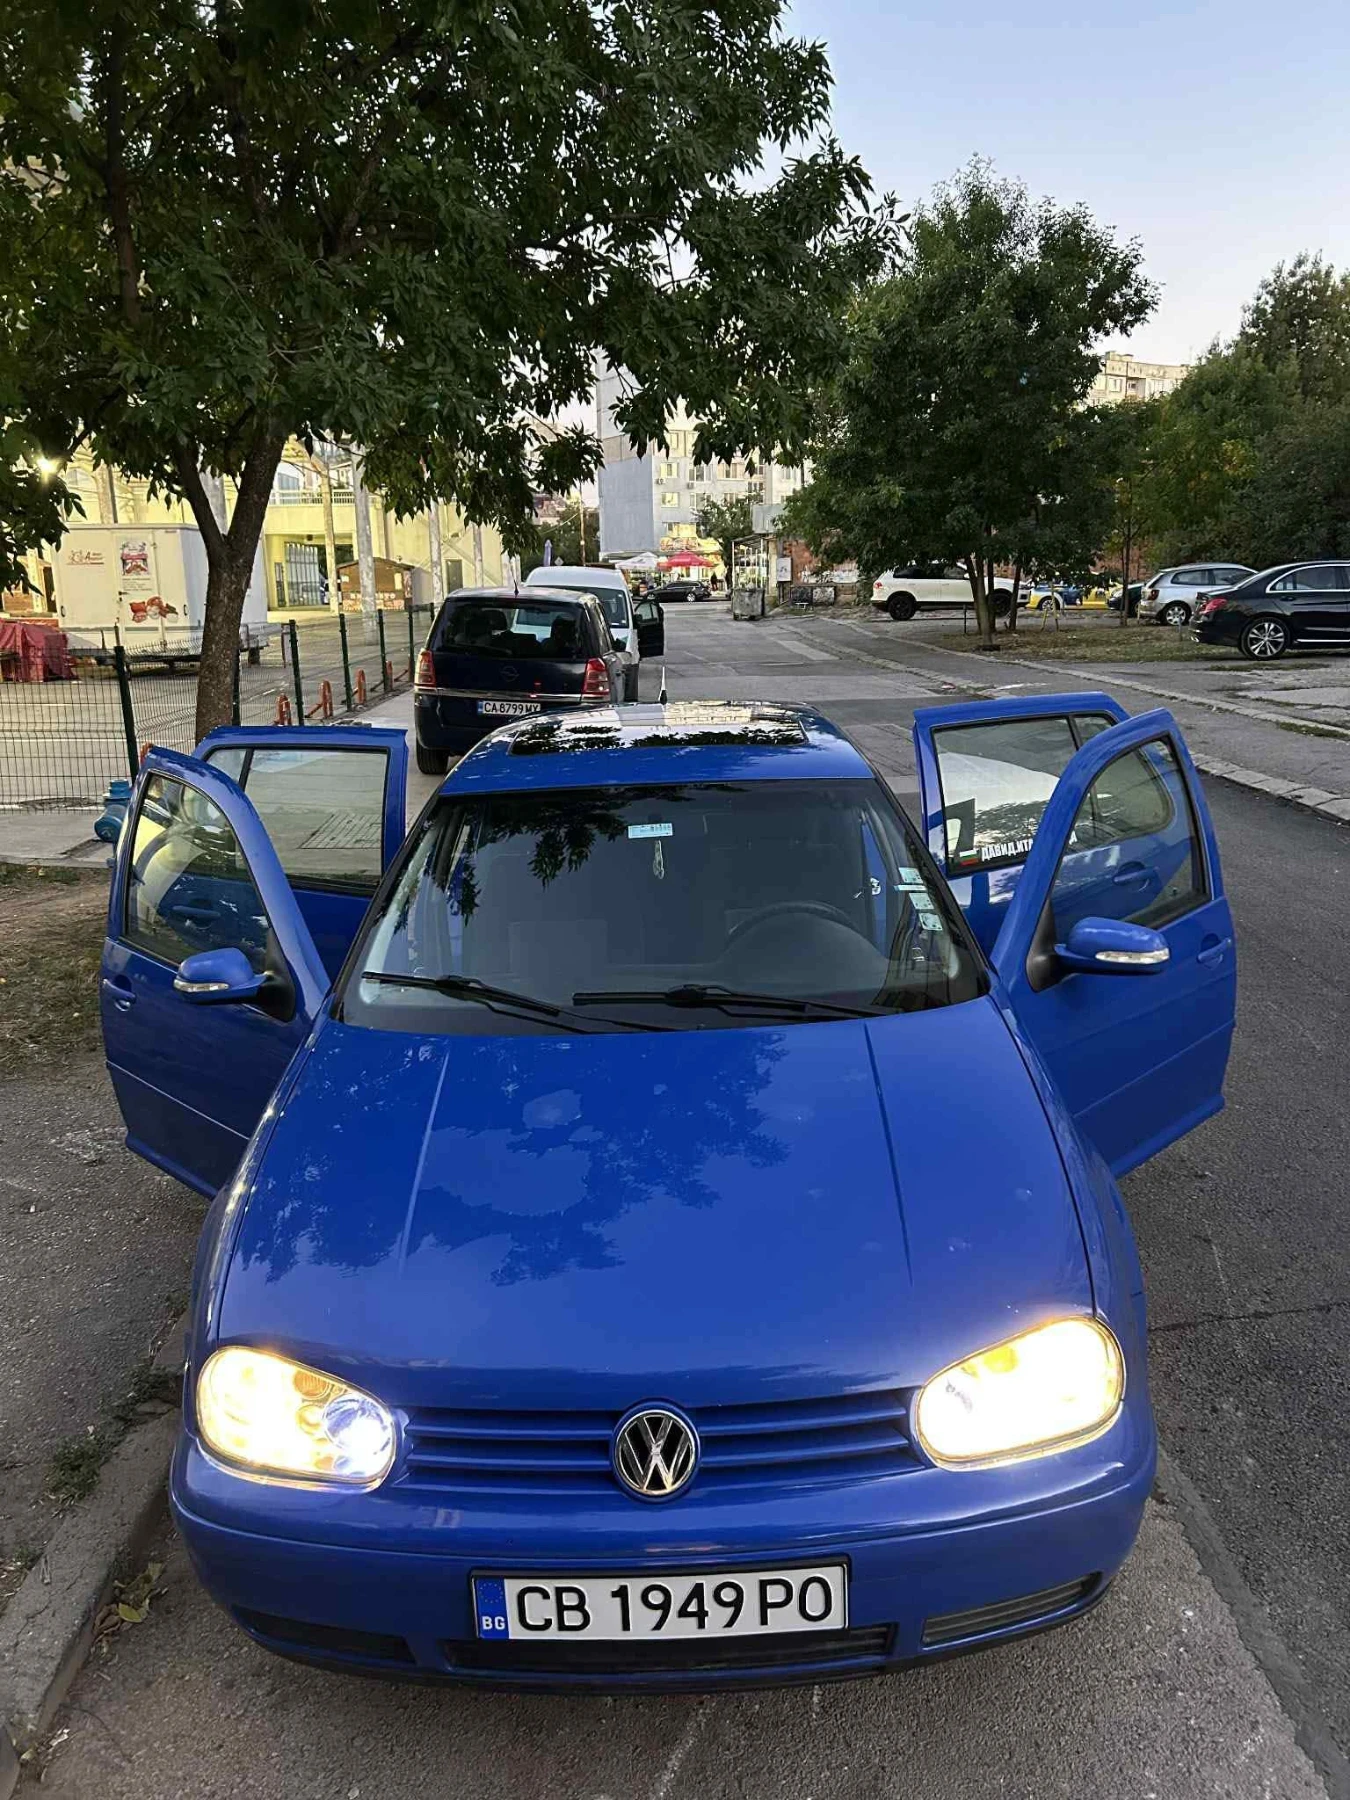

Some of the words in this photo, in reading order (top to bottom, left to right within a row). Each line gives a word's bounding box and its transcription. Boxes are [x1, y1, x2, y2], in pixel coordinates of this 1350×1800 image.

[484, 702, 498, 713] CA
[499, 703, 524, 714] 8799
[517, 1586, 591, 1632] CB
[611, 1581, 744, 1632] 1949
[759, 1576, 832, 1626] PO
[482, 1616, 505, 1630] BG
